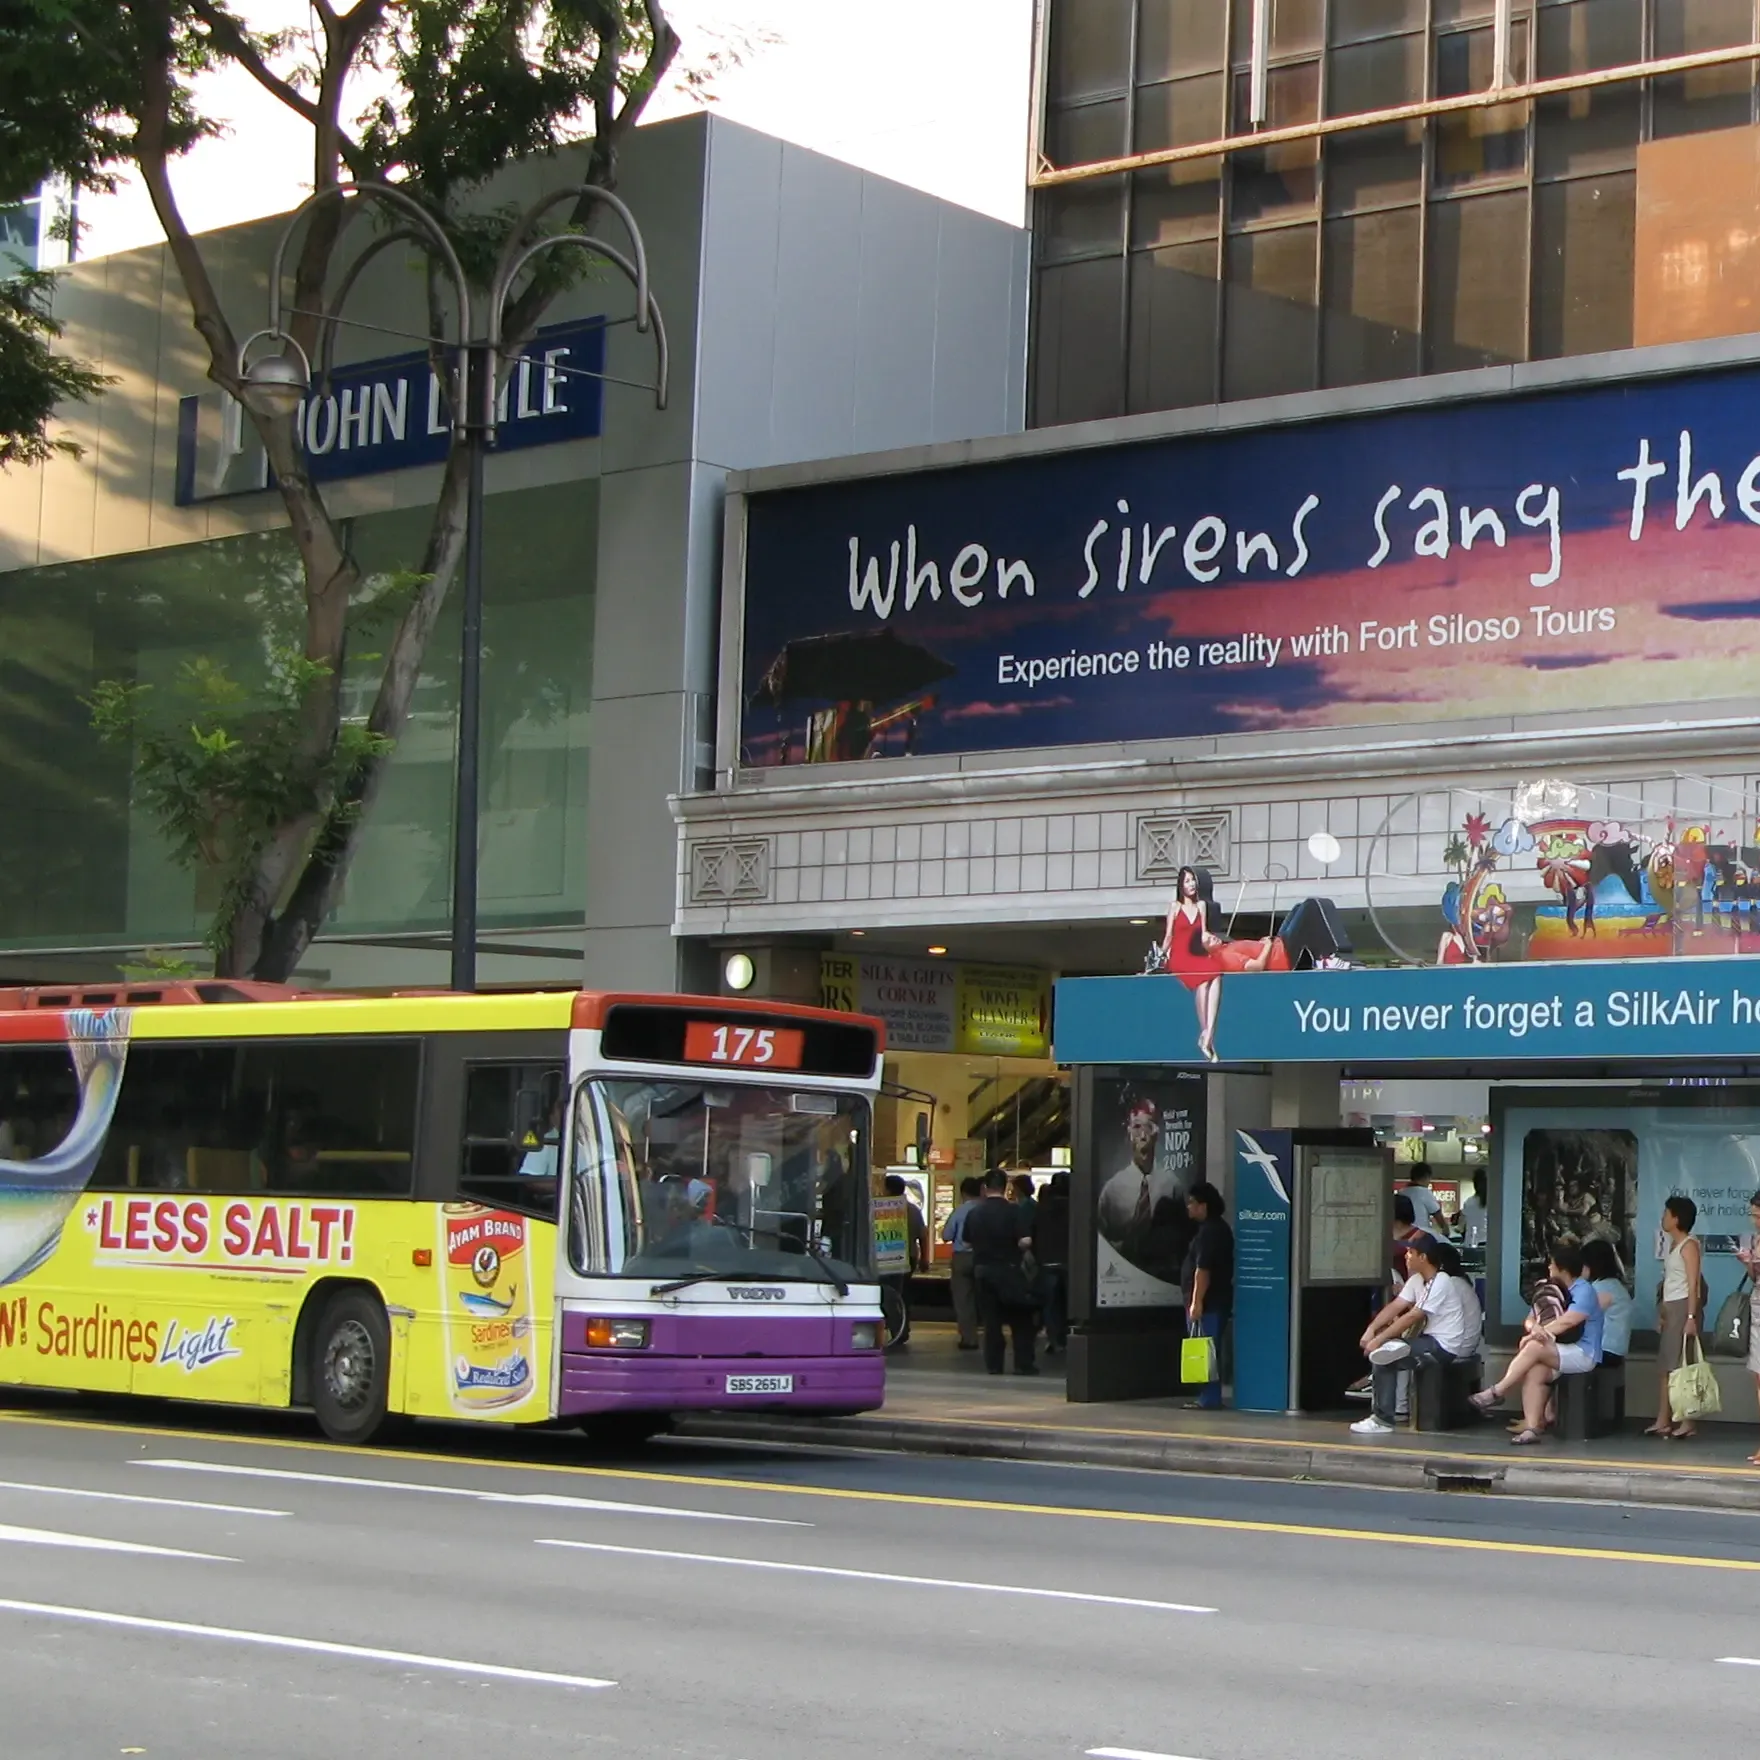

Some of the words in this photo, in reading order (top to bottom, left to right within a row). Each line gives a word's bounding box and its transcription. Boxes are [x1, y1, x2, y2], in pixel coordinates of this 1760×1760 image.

[848, 523, 1036, 620] When
[1078, 494, 1320, 600] sirens
[1366, 483, 1563, 588] sang
[998, 648, 1140, 688] Experience
[1147, 639, 1191, 670] the
[1198, 631, 1283, 667] reality
[1290, 624, 1350, 658] with
[1359, 618, 1418, 652] Fort
[1427, 614, 1521, 647] Siloso
[1529, 604, 1616, 637] Tours
[862, 964, 896, 984] SILK
[899, 968, 911, 984] &
[913, 969, 955, 986] GIFTS
[877, 984, 938, 1005] CORNER
[1293, 999, 1350, 1032] You
[1362, 1001, 1454, 1031] never
[1463, 995, 1563, 1037] forget
[1574, 1002, 1595, 1027] a
[1605, 990, 1721, 1027] SilkAir
[711, 1025, 776, 1063] 175
[1165, 1131, 1190, 1151] NDP
[1692, 1187, 1725, 1199] never
[223, 1203, 354, 1261] SALT!
[1239, 1208, 1286, 1221] silkair.com
[448, 1224, 480, 1255] AYAM
[484, 1219, 522, 1240] BRAND
[726, 1286, 787, 1300] VOLVO
[36, 1301, 158, 1364] Sardines
[160, 1316, 237, 1370] Light
